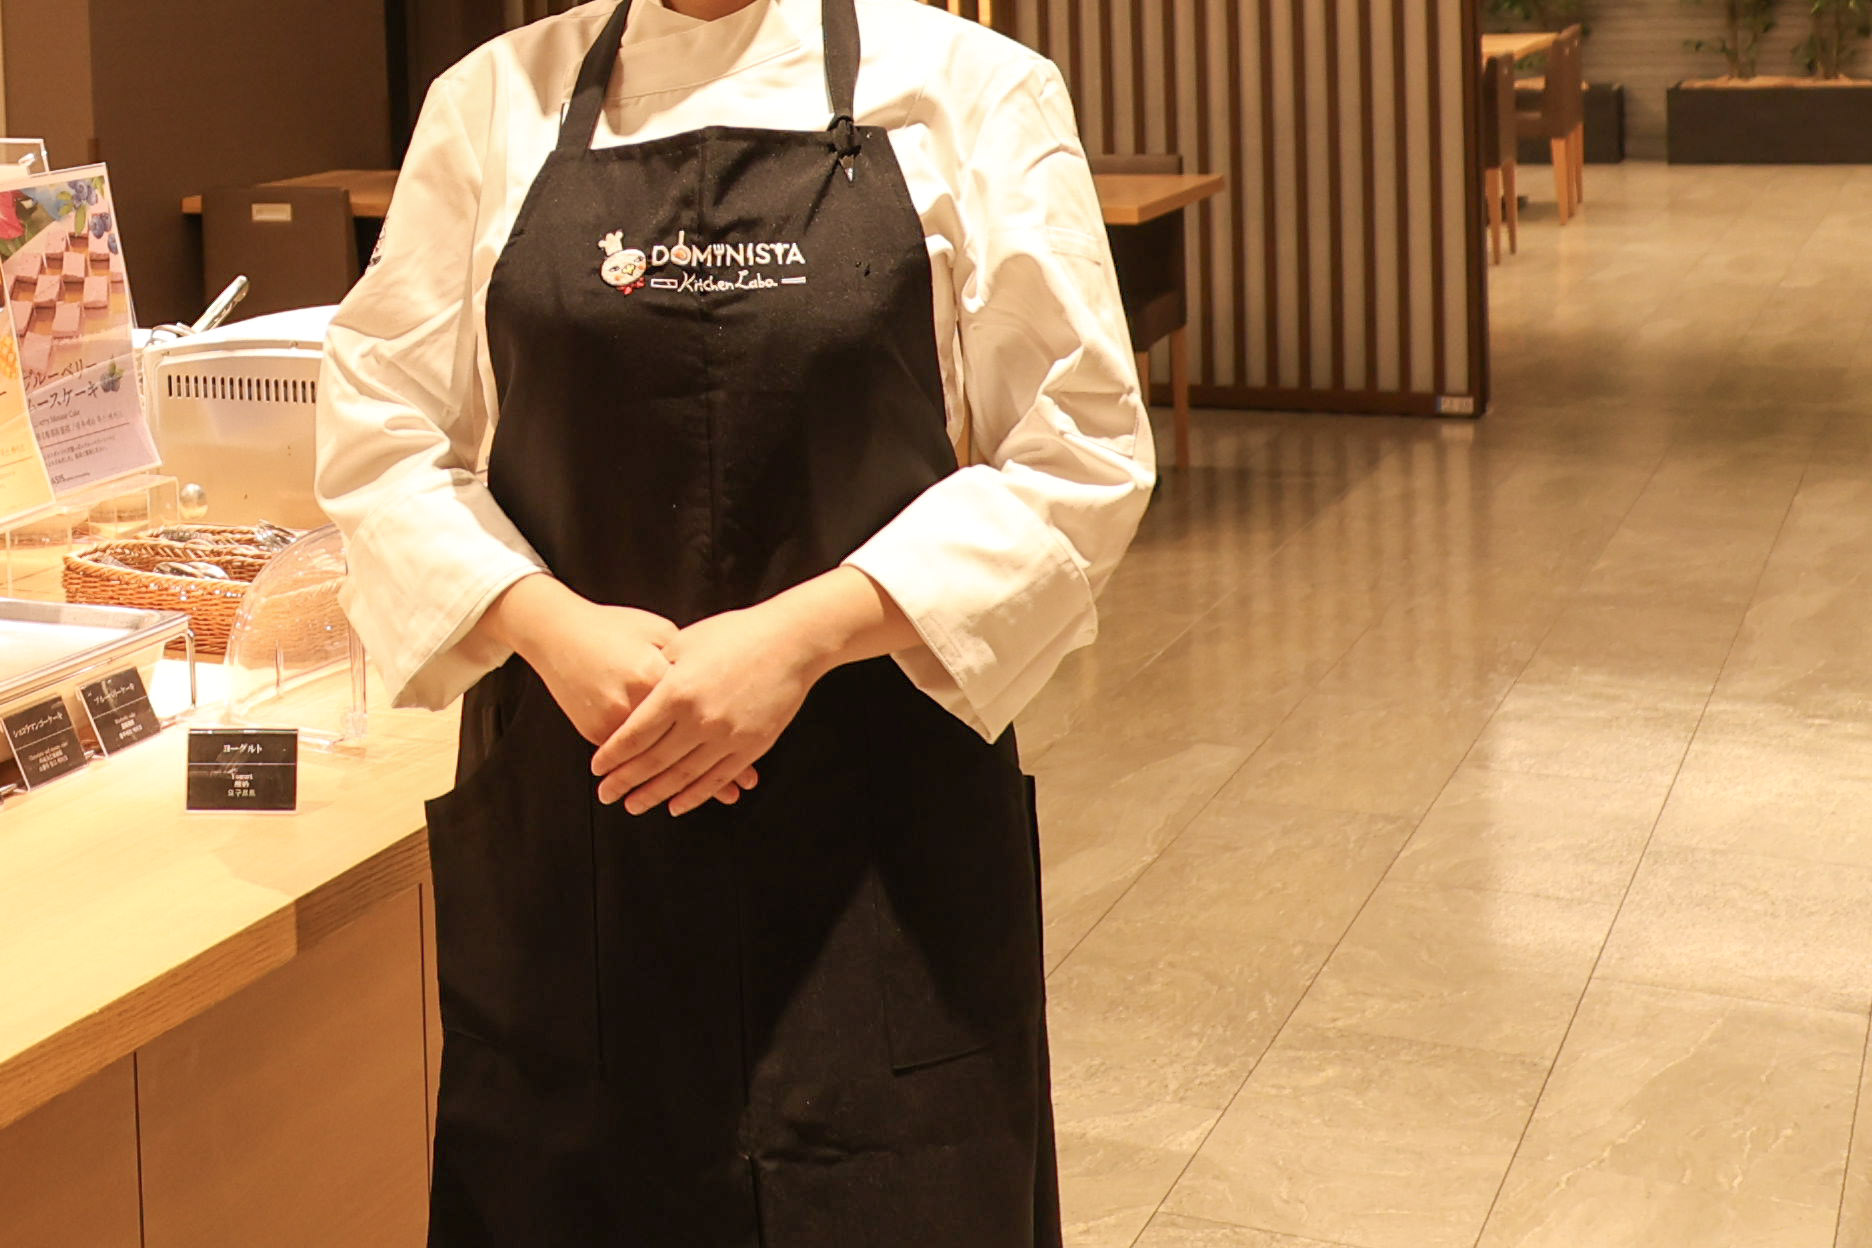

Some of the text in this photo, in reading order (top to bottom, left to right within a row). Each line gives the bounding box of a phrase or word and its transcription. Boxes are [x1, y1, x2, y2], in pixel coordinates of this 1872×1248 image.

[678, 271, 735, 292] Kitchen
[223, 743, 263, 754] ヨーグルト
